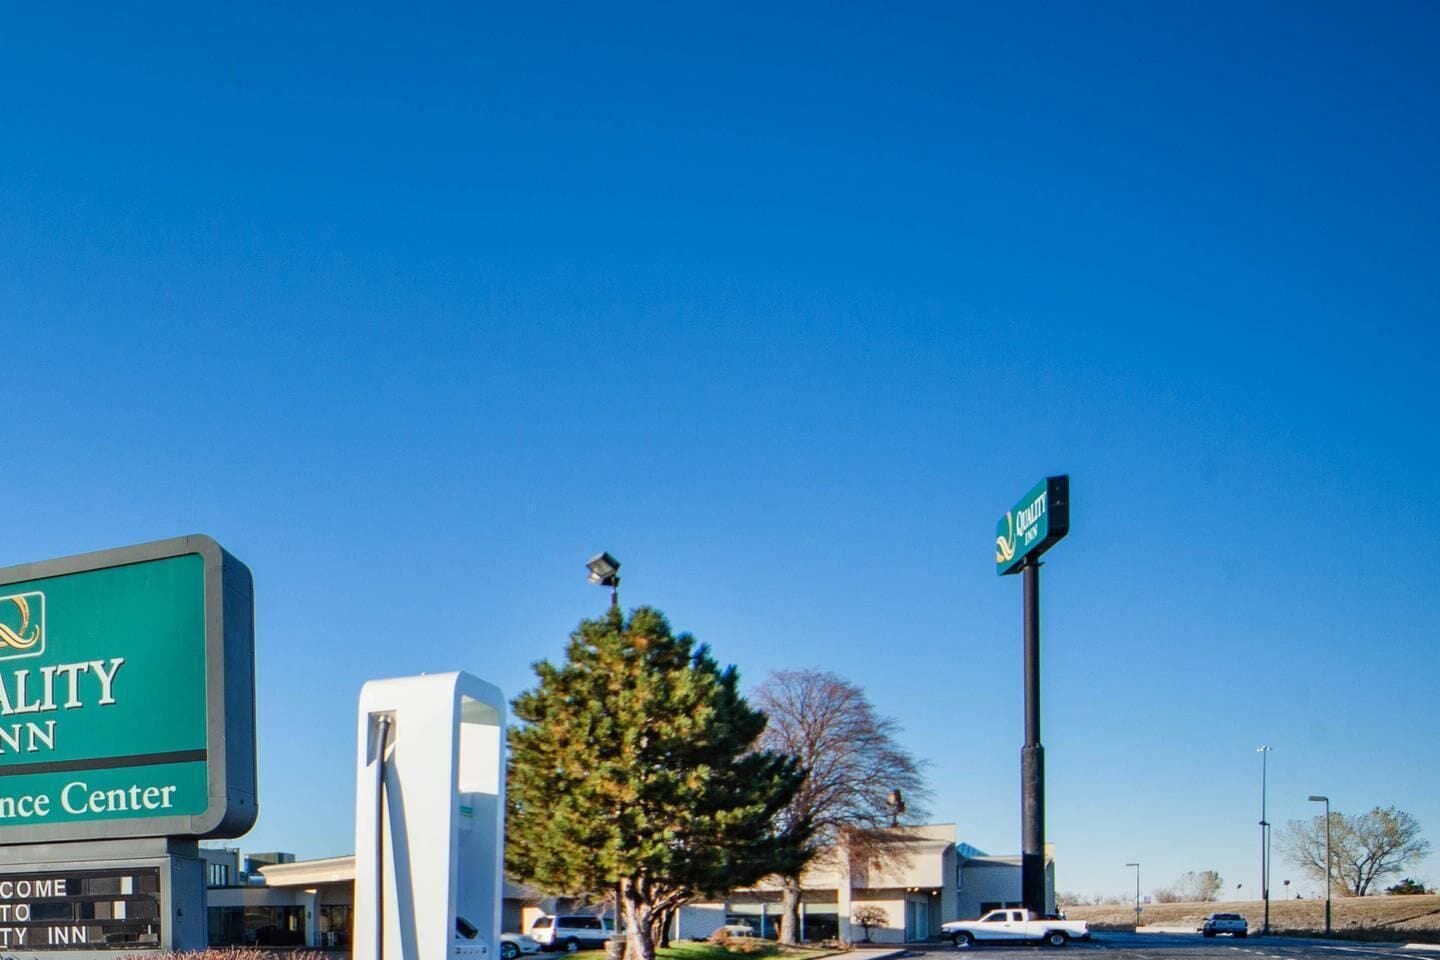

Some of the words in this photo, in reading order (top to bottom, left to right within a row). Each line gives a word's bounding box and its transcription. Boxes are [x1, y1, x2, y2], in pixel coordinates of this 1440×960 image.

[1016, 490, 1047, 536] QUALITY
[1024, 523, 1038, 546] INN
[61, 781, 177, 814] Center
[48, 925, 87, 945] INN
